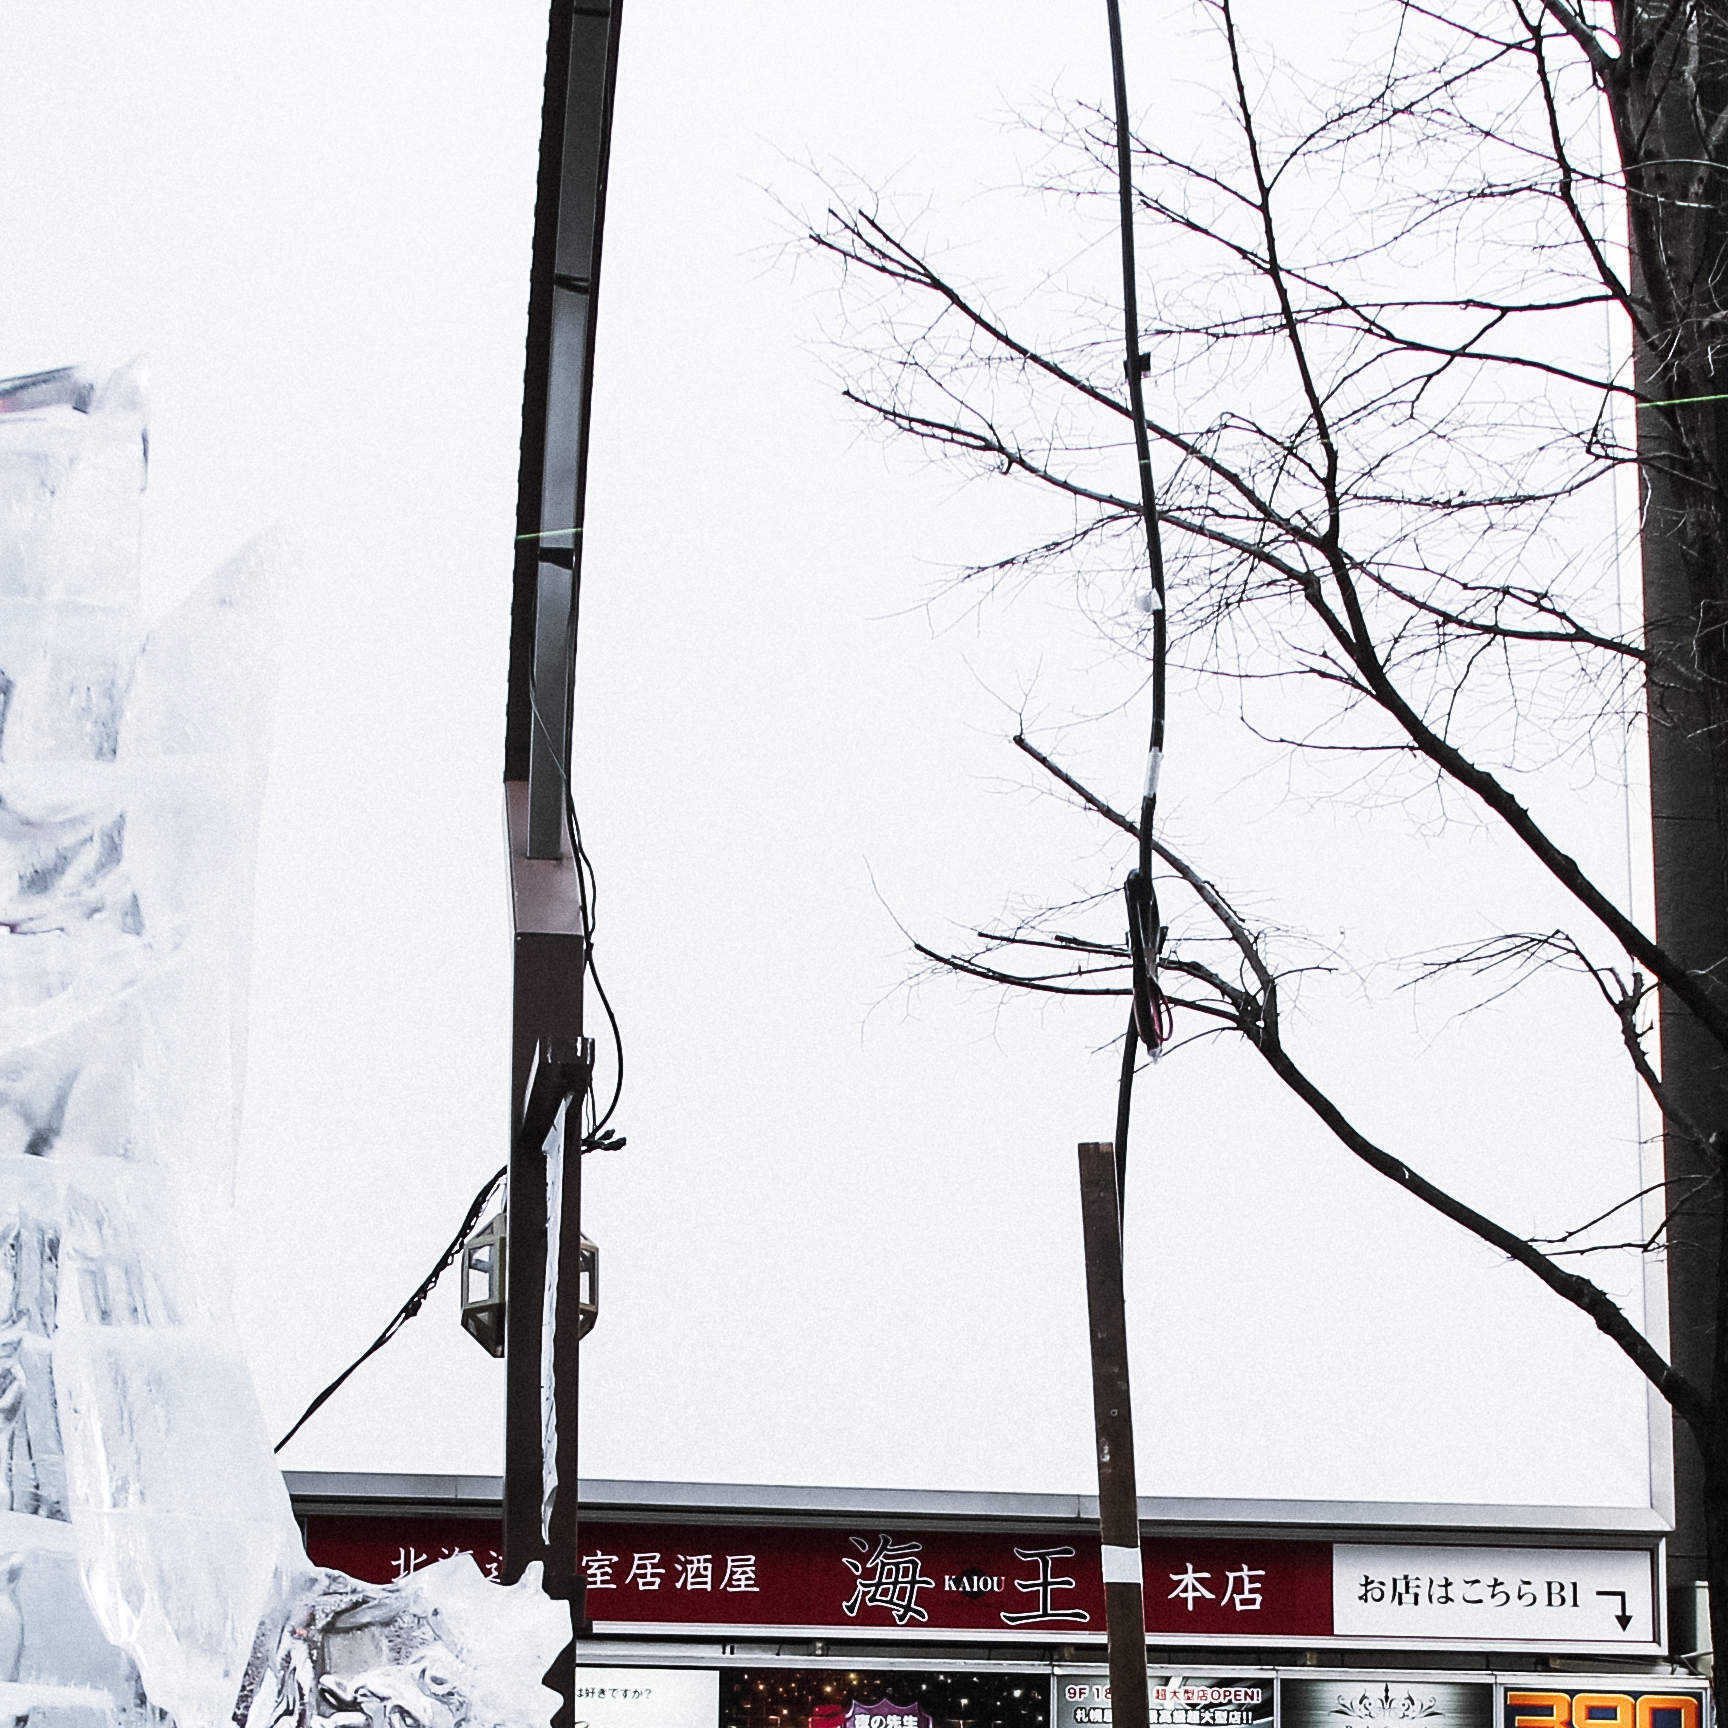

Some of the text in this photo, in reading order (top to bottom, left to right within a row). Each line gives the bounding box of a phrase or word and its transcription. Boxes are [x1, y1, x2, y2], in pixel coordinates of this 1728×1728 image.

[842, 1533, 1267, 1625] 海 KAIOU 王 本店
[1067, 1687, 1087, 1699] 9F
